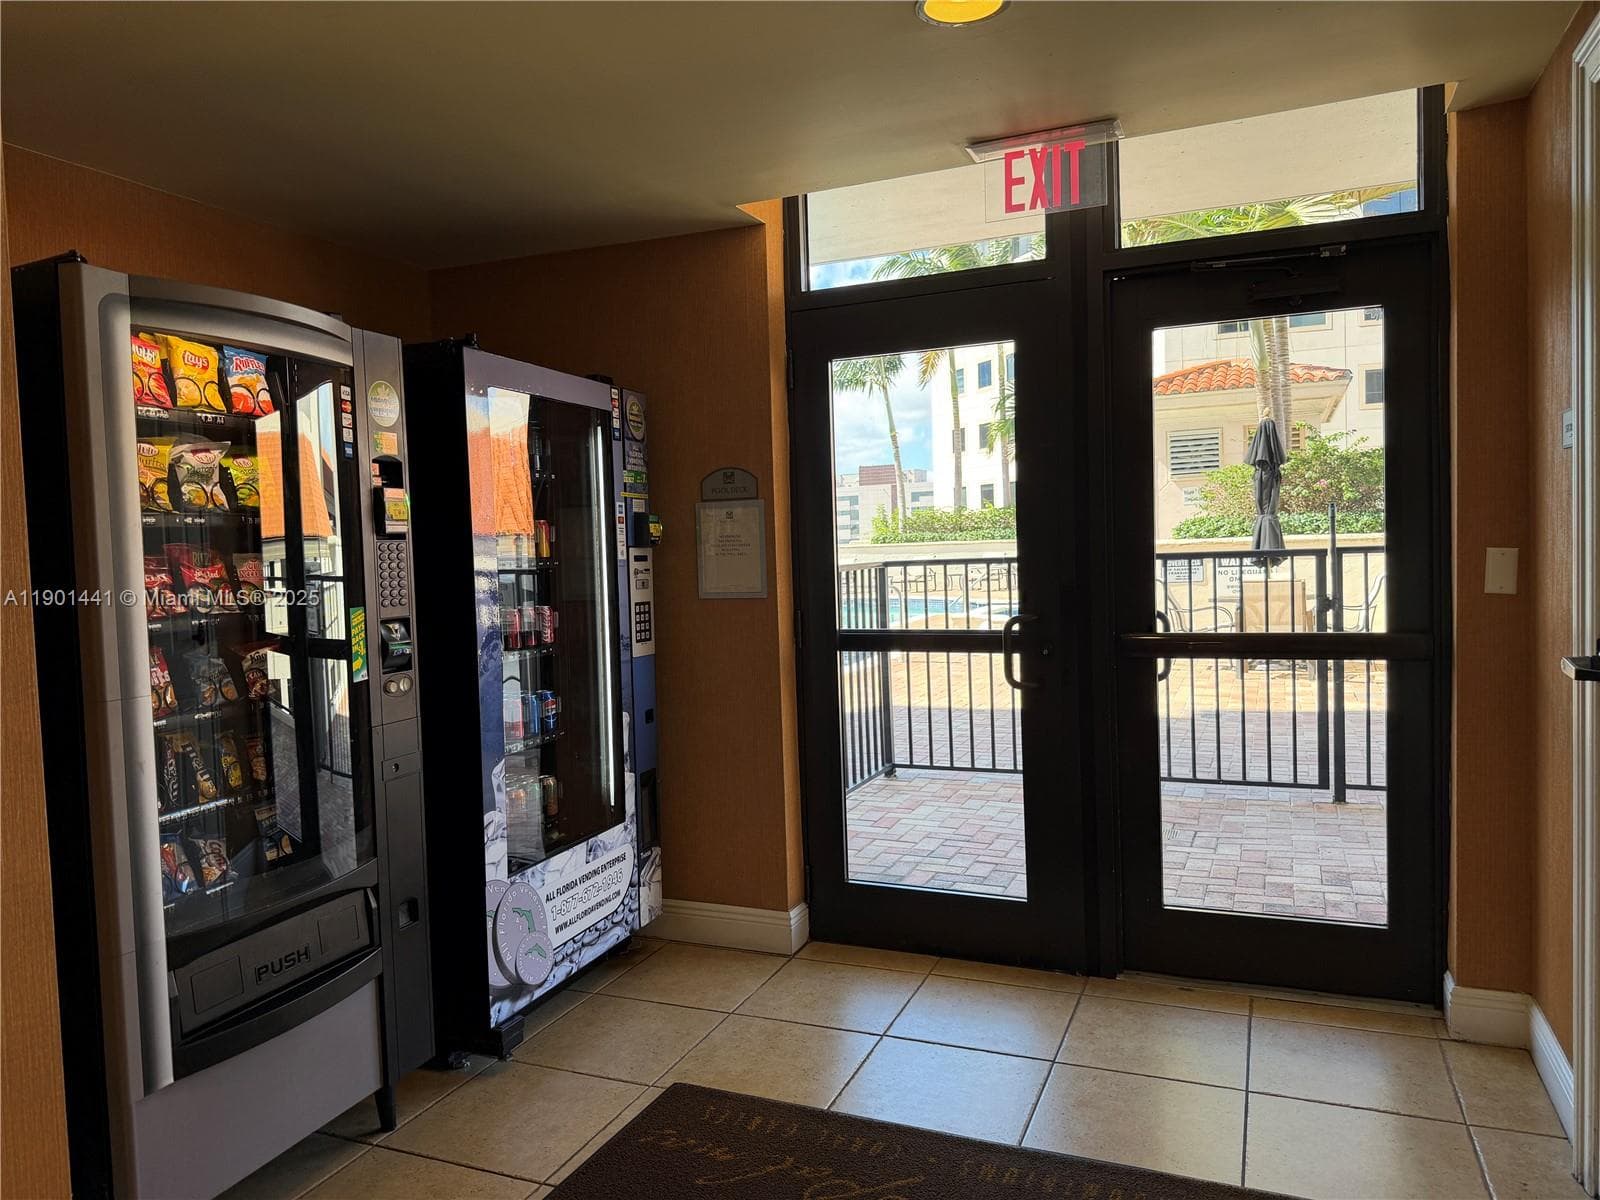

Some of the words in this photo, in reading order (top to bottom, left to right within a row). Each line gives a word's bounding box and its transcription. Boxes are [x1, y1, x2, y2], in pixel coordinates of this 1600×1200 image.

[1004, 140, 1086, 214] EXIT
[545, 890, 556, 904] ALL
[556, 878, 579, 898] FLORIDA
[578, 866, 601, 886] VENDING
[600, 851, 627, 874] ENTERPRISE
[254, 945, 311, 984] PUSH
